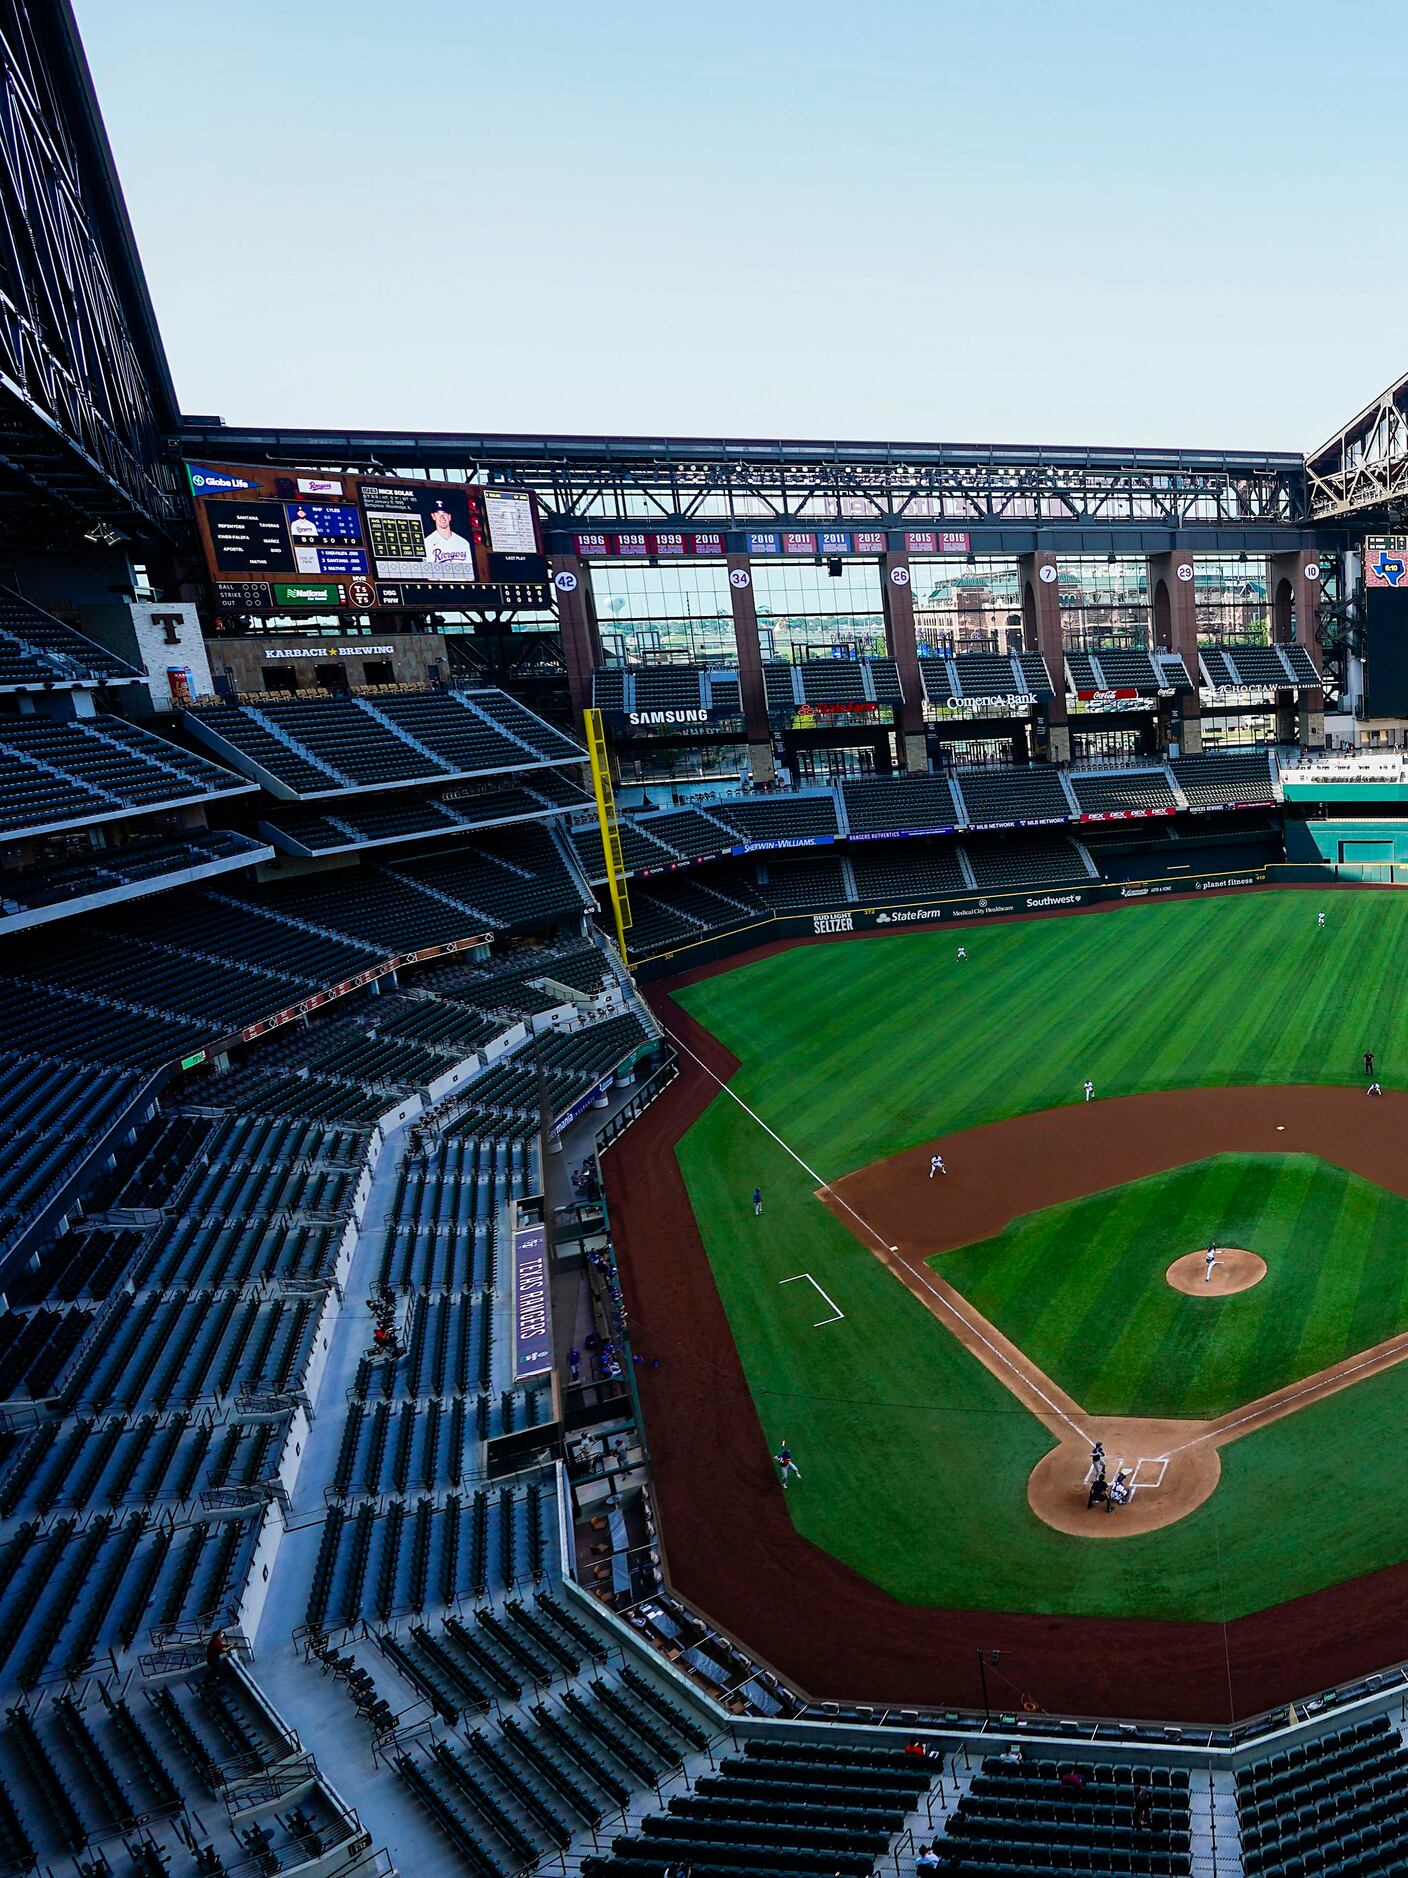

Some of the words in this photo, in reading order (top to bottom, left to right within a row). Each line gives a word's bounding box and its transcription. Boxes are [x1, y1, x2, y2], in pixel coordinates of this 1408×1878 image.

[205, 478, 231, 488] Globe
[232, 480, 249, 488] Life
[308, 481, 332, 491] Rangers
[578, 535, 605, 544] 1996
[618, 535, 645, 544] 1998
[656, 534, 682, 544] 1999
[695, 534, 720, 544] 2010
[751, 534, 774, 544] 2010
[788, 534, 810, 543] 2011
[824, 534, 845, 542] 2011
[858, 534, 880, 542] 2012
[910, 534, 931, 542] 2015
[944, 534, 965, 542] 2016
[432, 549, 467, 563] Rangers
[893, 570, 907, 581] 26
[1045, 569, 1052, 579] 7
[1178, 568, 1191, 578] 29
[557, 575, 574, 588] 42
[732, 574, 748, 584] 34
[297, 590, 328, 598] National
[151, 613, 184, 644] T
[265, 648, 328, 658] KARBACH
[338, 646, 394, 656] BREWING
[1224, 684, 1278, 694] CHOCTAW
[947, 696, 1004, 710] Comerica
[1006, 693, 1038, 706] Bank
[817, 703, 846, 714] State
[848, 702, 877, 712] Farm
[630, 709, 708, 725] SAMSUNG
[1202, 880, 1226, 890] planet
[1227, 878, 1253, 886] fitness
[1026, 895, 1075, 907] Southwest
[986, 905, 1014, 913] Healthcare
[892, 912, 917, 922] State
[917, 909, 940, 920] Farm
[814, 918, 854, 934] SELTZER
[520, 1258, 544, 1291] TEXAS
[520, 1291, 545, 1340] RANGERS
